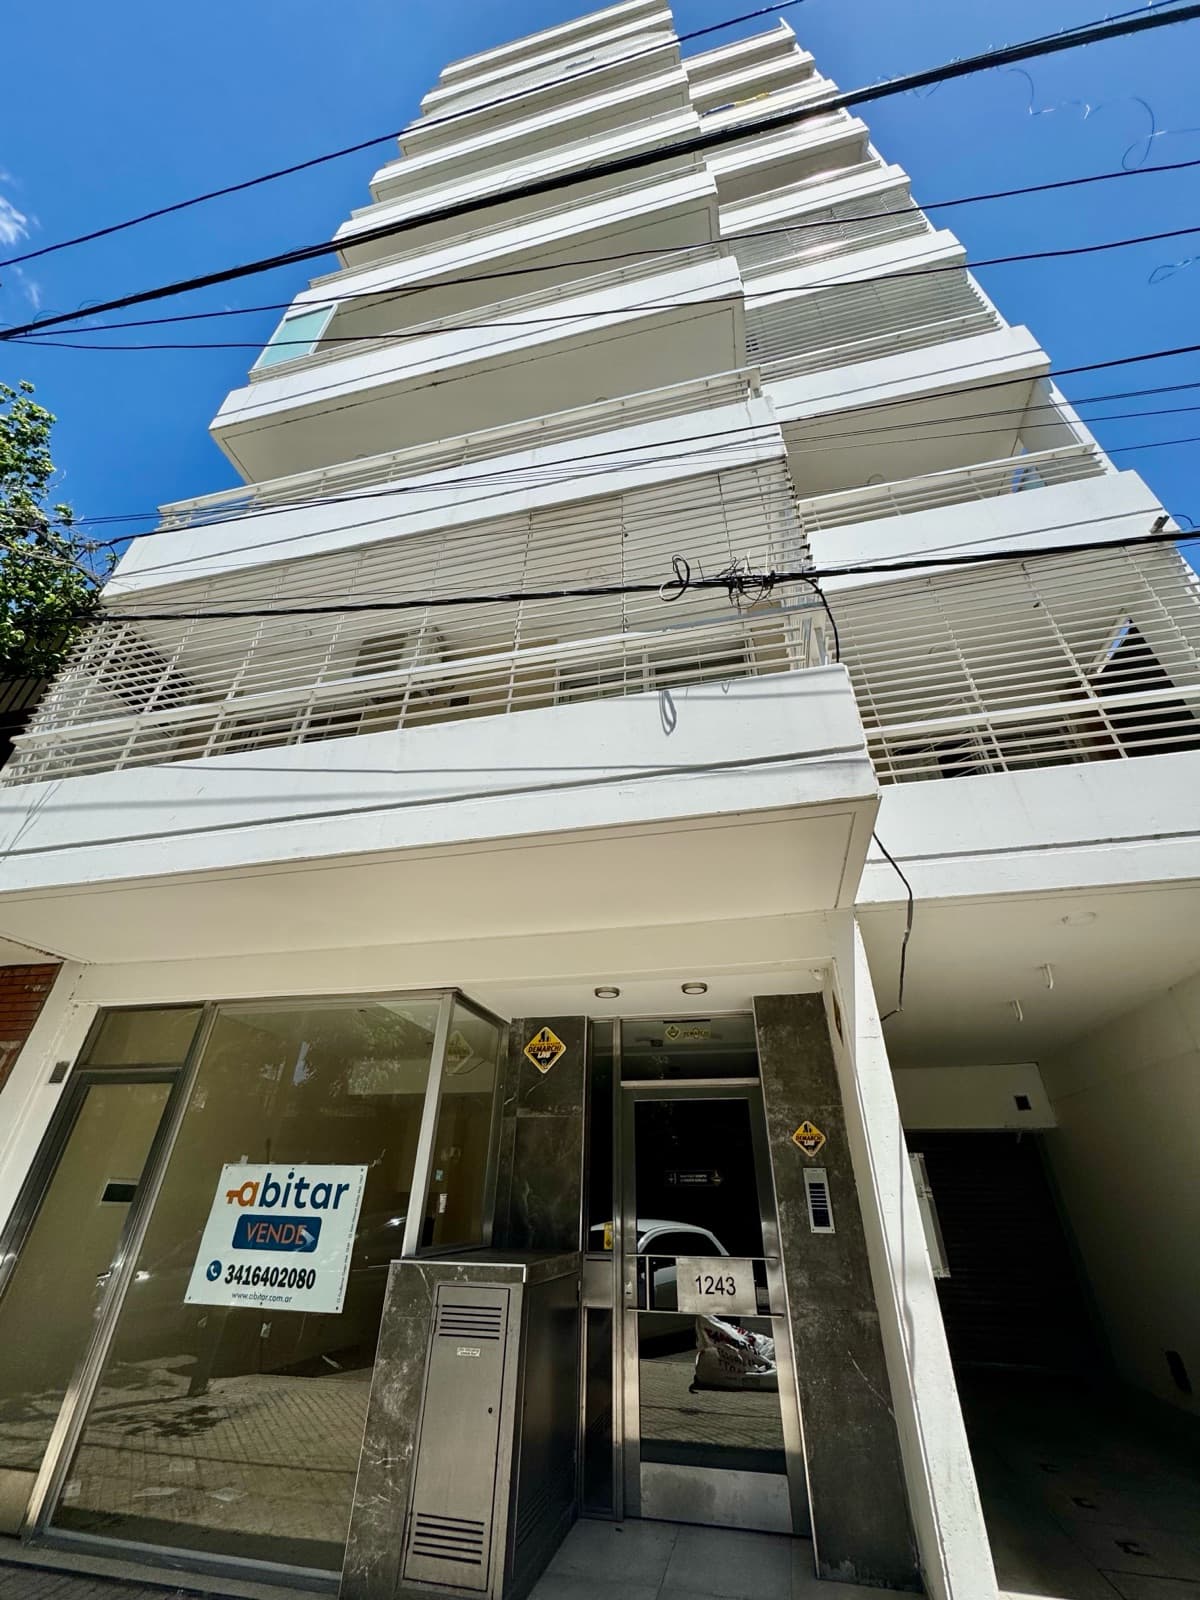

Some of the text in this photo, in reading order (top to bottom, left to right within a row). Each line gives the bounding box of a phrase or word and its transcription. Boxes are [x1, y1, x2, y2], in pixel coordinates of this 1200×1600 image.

[226, 1172, 350, 1210] abitar
[246, 1222, 308, 1245] VENDE
[224, 1264, 317, 1290] 3416402080
[695, 1275, 736, 1296] 1243
[231, 1292, 293, 1304] www.abitar.com.ar
